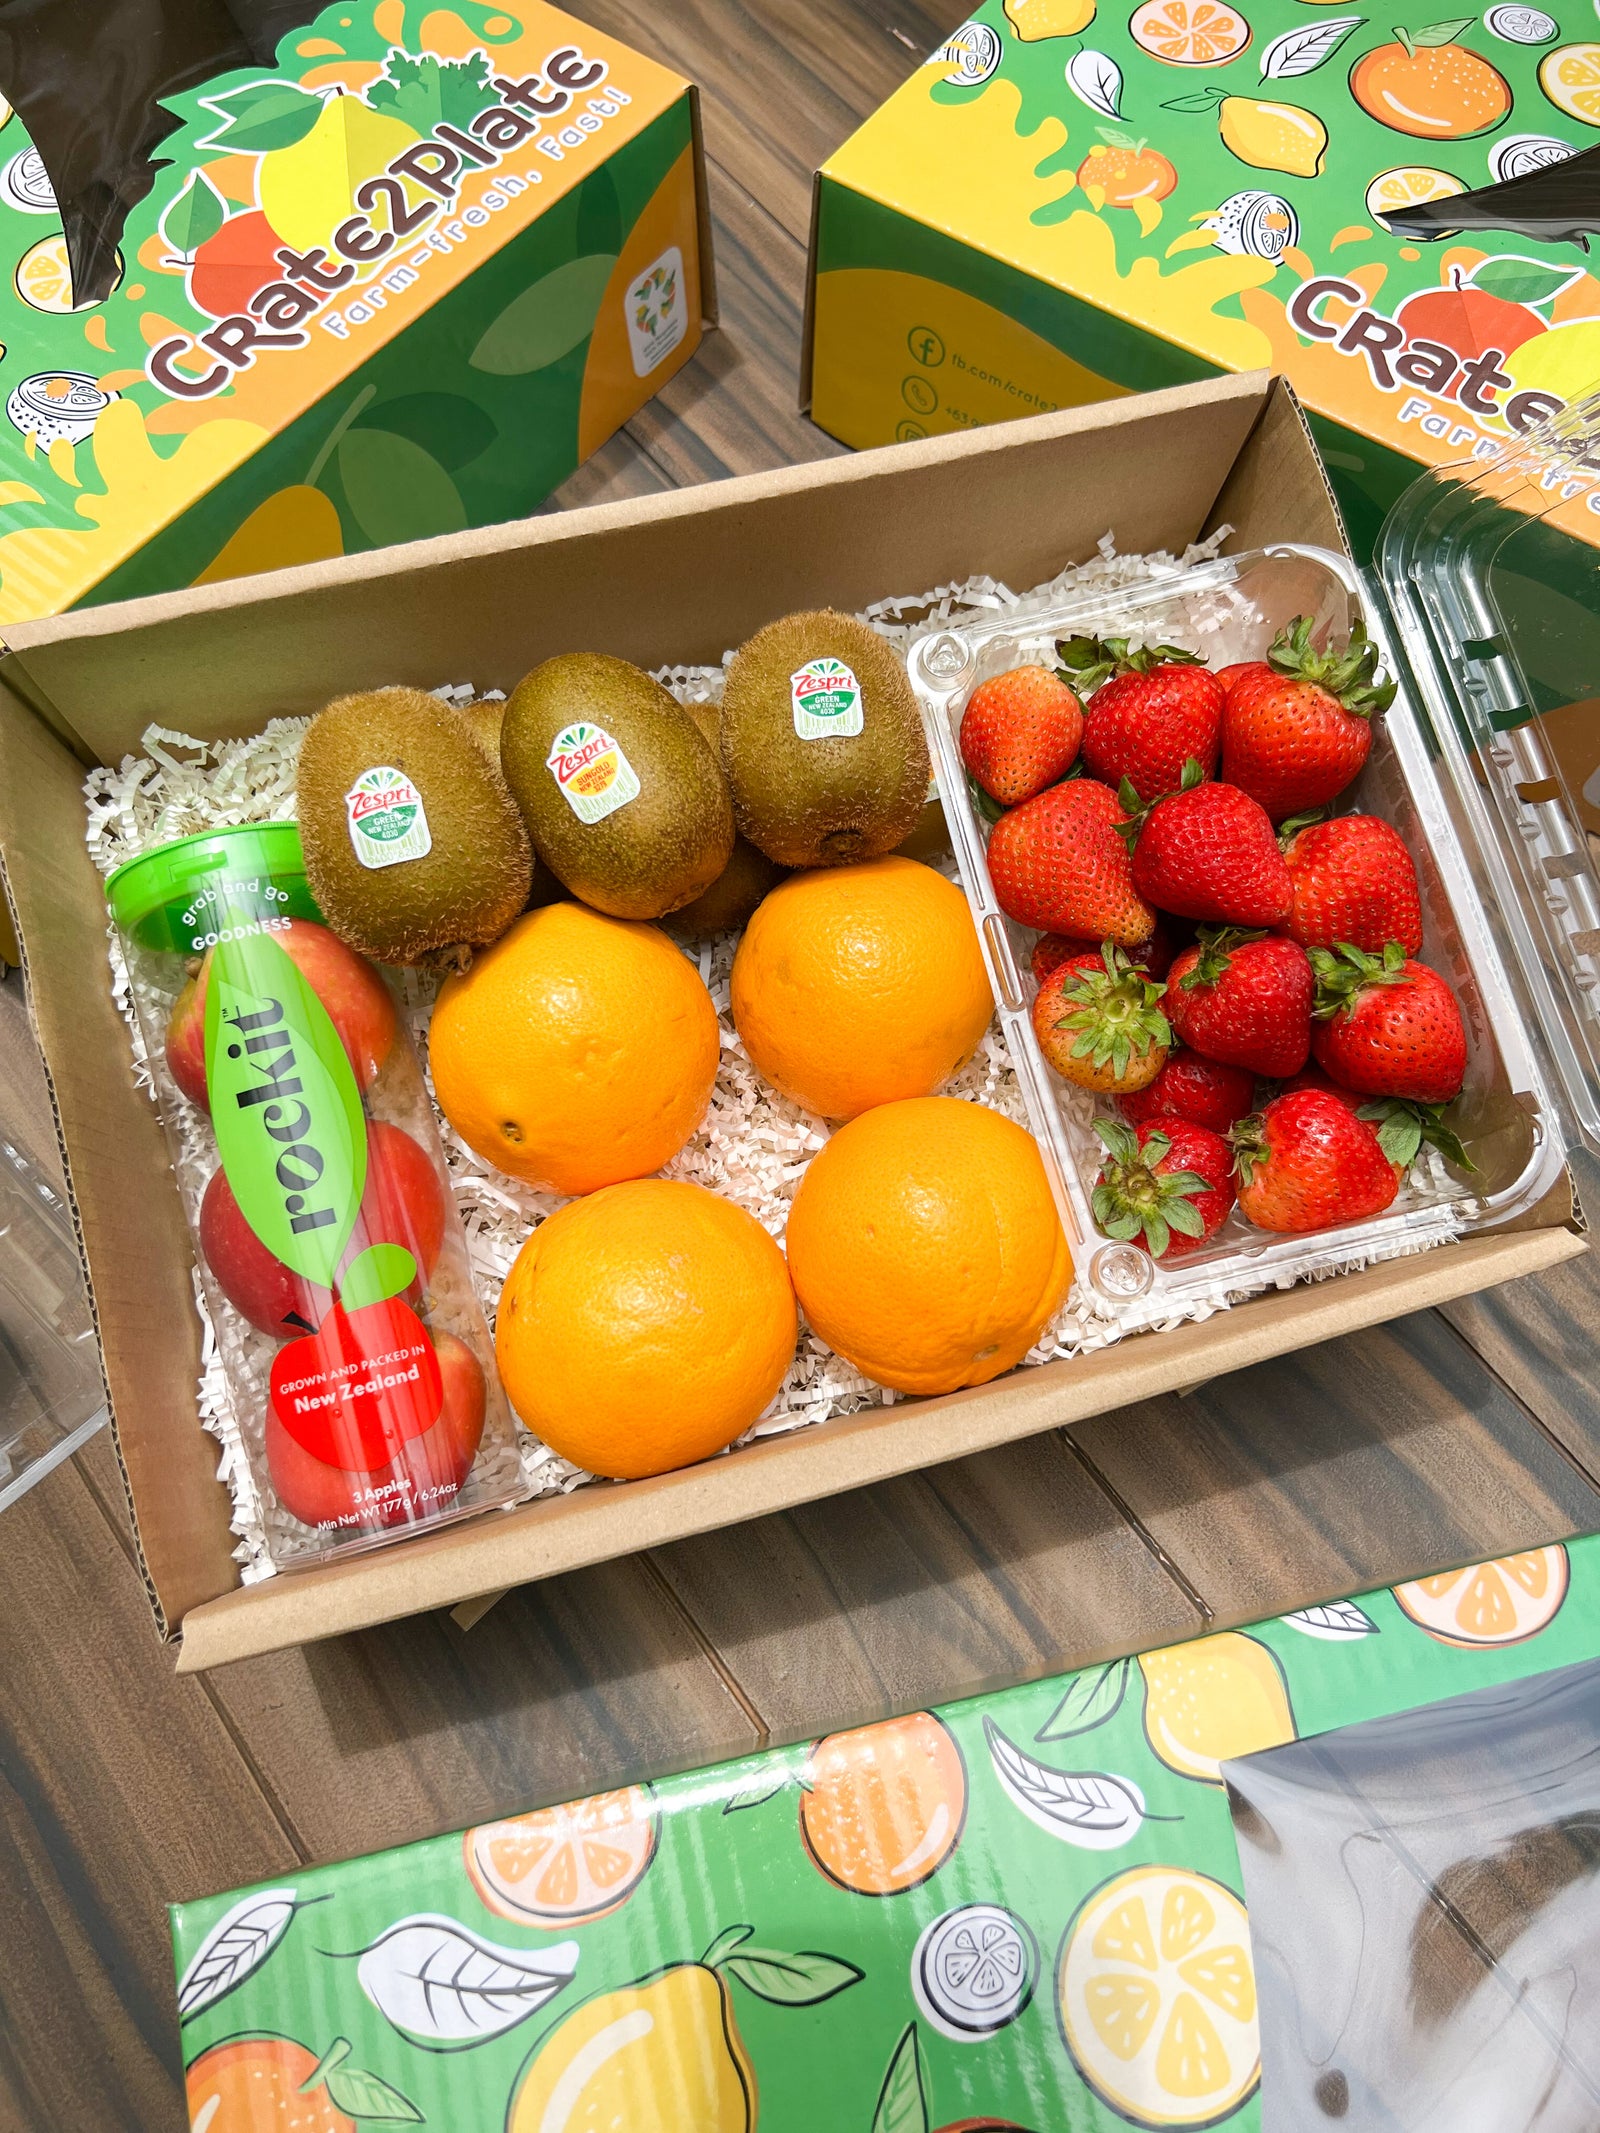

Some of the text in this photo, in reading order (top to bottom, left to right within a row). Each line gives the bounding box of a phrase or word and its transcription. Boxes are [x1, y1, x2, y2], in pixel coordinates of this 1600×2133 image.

[540, 88, 629, 161] Fast!
[794, 674, 853, 697] Zespri
[814, 695, 840, 704] GREEN
[808, 702, 821, 710] NEW
[549, 733, 613, 784] Zespri
[576, 761, 610, 786] SUNGOLD
[349, 785, 416, 820] Zespri
[373, 814, 402, 826] GREEN
[367, 826, 382, 835] NEW
[181, 878, 290, 927] grab and go
[191, 916, 293, 952] GOODNESS
[225, 997, 337, 1235] rockit
[279, 1343, 426, 1396] GROWN AND PACKED IN
[294, 1364, 420, 1414] New Zealand
[317, 1520, 338, 1533] Min
[338, 1512, 361, 1528] Net
[359, 1504, 383, 1520] WT
[382, 1496, 411, 1515] 177g
[421, 1481, 458, 1502] 6.24oz
[352, 1478, 412, 1504] 3 Apples
